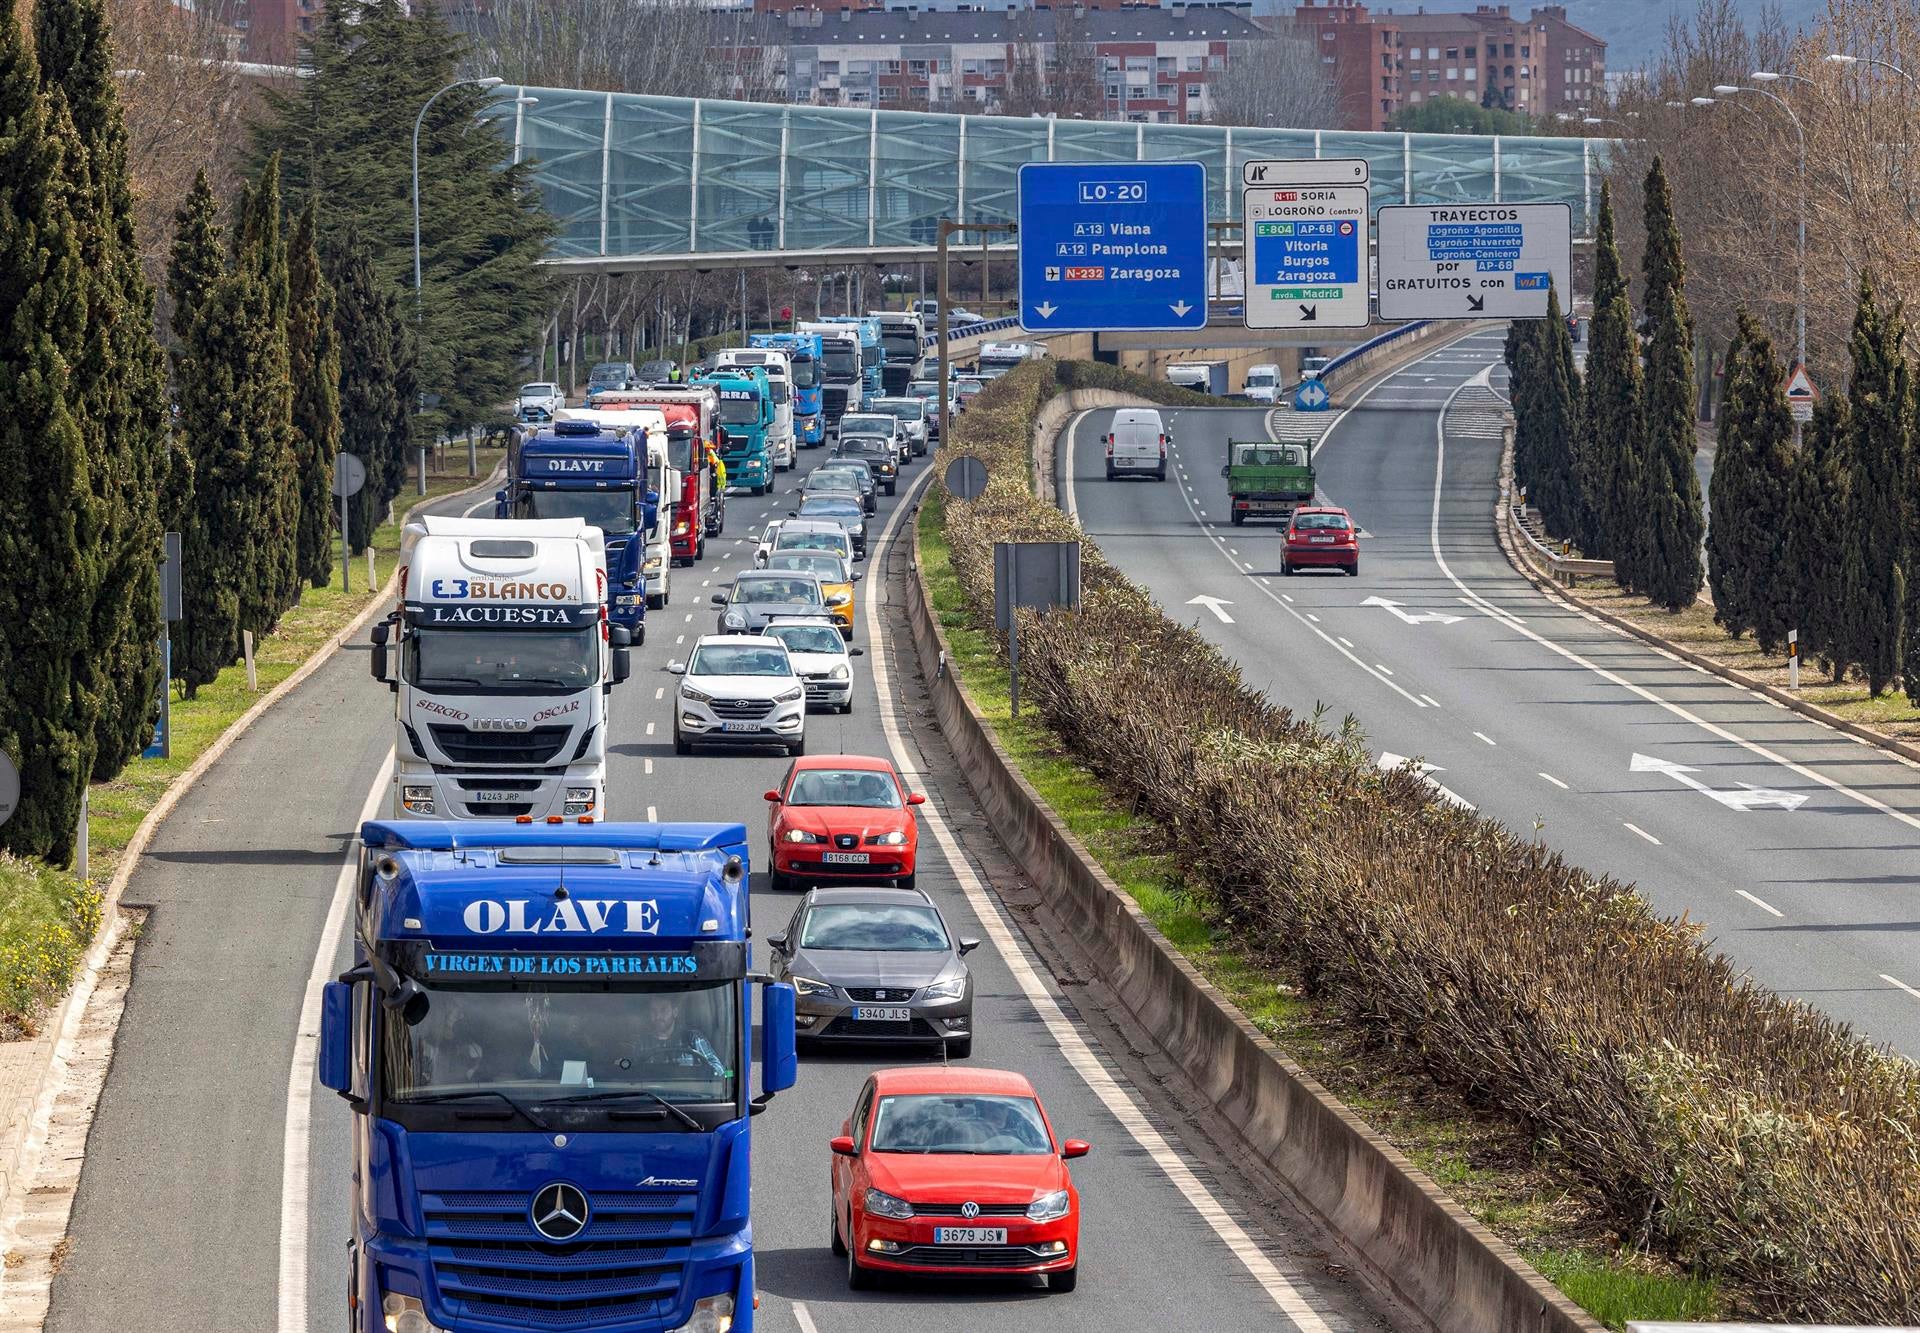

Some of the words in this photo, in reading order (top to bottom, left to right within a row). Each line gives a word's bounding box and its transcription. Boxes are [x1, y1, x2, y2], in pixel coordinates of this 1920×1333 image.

[1354, 167, 1361, 176] 9
[1083, 185, 1143, 200] LO-20
[1301, 192, 1336, 200] SORIA
[1268, 205, 1325, 216] LOGROÑO
[1431, 210, 1518, 222] TRAYECTOS
[1076, 224, 1103, 234] A-13
[1110, 223, 1151, 235] Viana
[1258, 225, 1292, 234] E-804
[1300, 225, 1333, 233] AP-68
[1059, 245, 1085, 254] A-12
[1092, 243, 1168, 258] Pamplona
[1285, 241, 1328, 251] Vitoria
[1284, 256, 1330, 267] Burgos
[1437, 262, 1460, 273] por
[1478, 261, 1513, 270] AP-68
[1066, 268, 1103, 279] N-232
[1110, 267, 1180, 281] Zaragoza
[1277, 271, 1336, 282] Zaragoza
[1386, 278, 1471, 290] GRATUITOS
[1480, 278, 1505, 288] con
[1303, 289, 1339, 299] Madrid
[548, 460, 604, 472] OLAVE
[470, 582, 567, 600] BLANCO
[433, 607, 571, 623] LACUESTA
[416, 699, 469, 721] SERGIO
[533, 700, 580, 722] OSCAR
[472, 718, 528, 730] IVECO
[728, 723, 745, 731] 2322
[482, 792, 502, 800] 4243
[504, 792, 520, 800] JRP
[828, 853, 848, 862] 8168
[851, 854, 868, 863] CCX
[463, 898, 660, 936] OLAVE
[425, 955, 505, 973] VIRGEN
[509, 956, 536, 973] DE
[540, 957, 580, 974] LOS
[585, 956, 697, 974] PARRALES
[859, 1009, 885, 1018] 5940
[889, 1009, 908, 1019] JLS
[943, 1230, 975, 1241] 3679
[979, 1230, 1003, 1242] JSW
